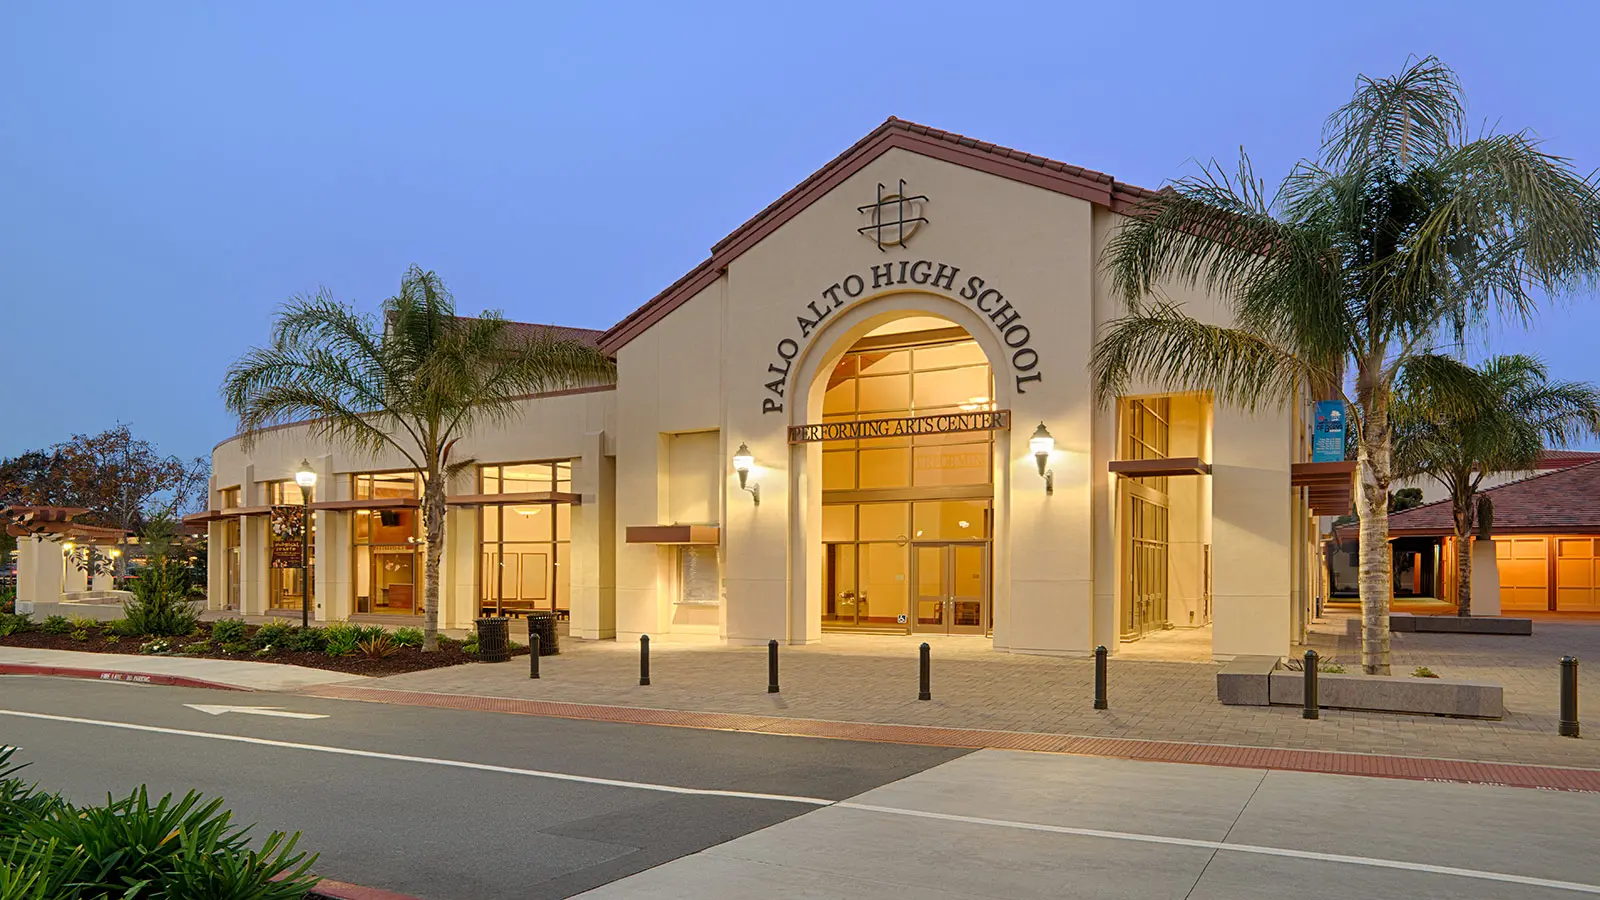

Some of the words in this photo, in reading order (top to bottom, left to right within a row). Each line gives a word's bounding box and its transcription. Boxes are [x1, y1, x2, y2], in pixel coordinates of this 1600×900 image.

[762, 338, 798, 415] PALO
[796, 274, 865, 338] ALTO
[870, 260, 960, 290] HIGH
[959, 276, 1042, 394] SCHOOL
[792, 420, 889, 441] PERFORMING
[893, 417, 934, 435] ARTS
[936, 412, 1005, 432] CENTER
